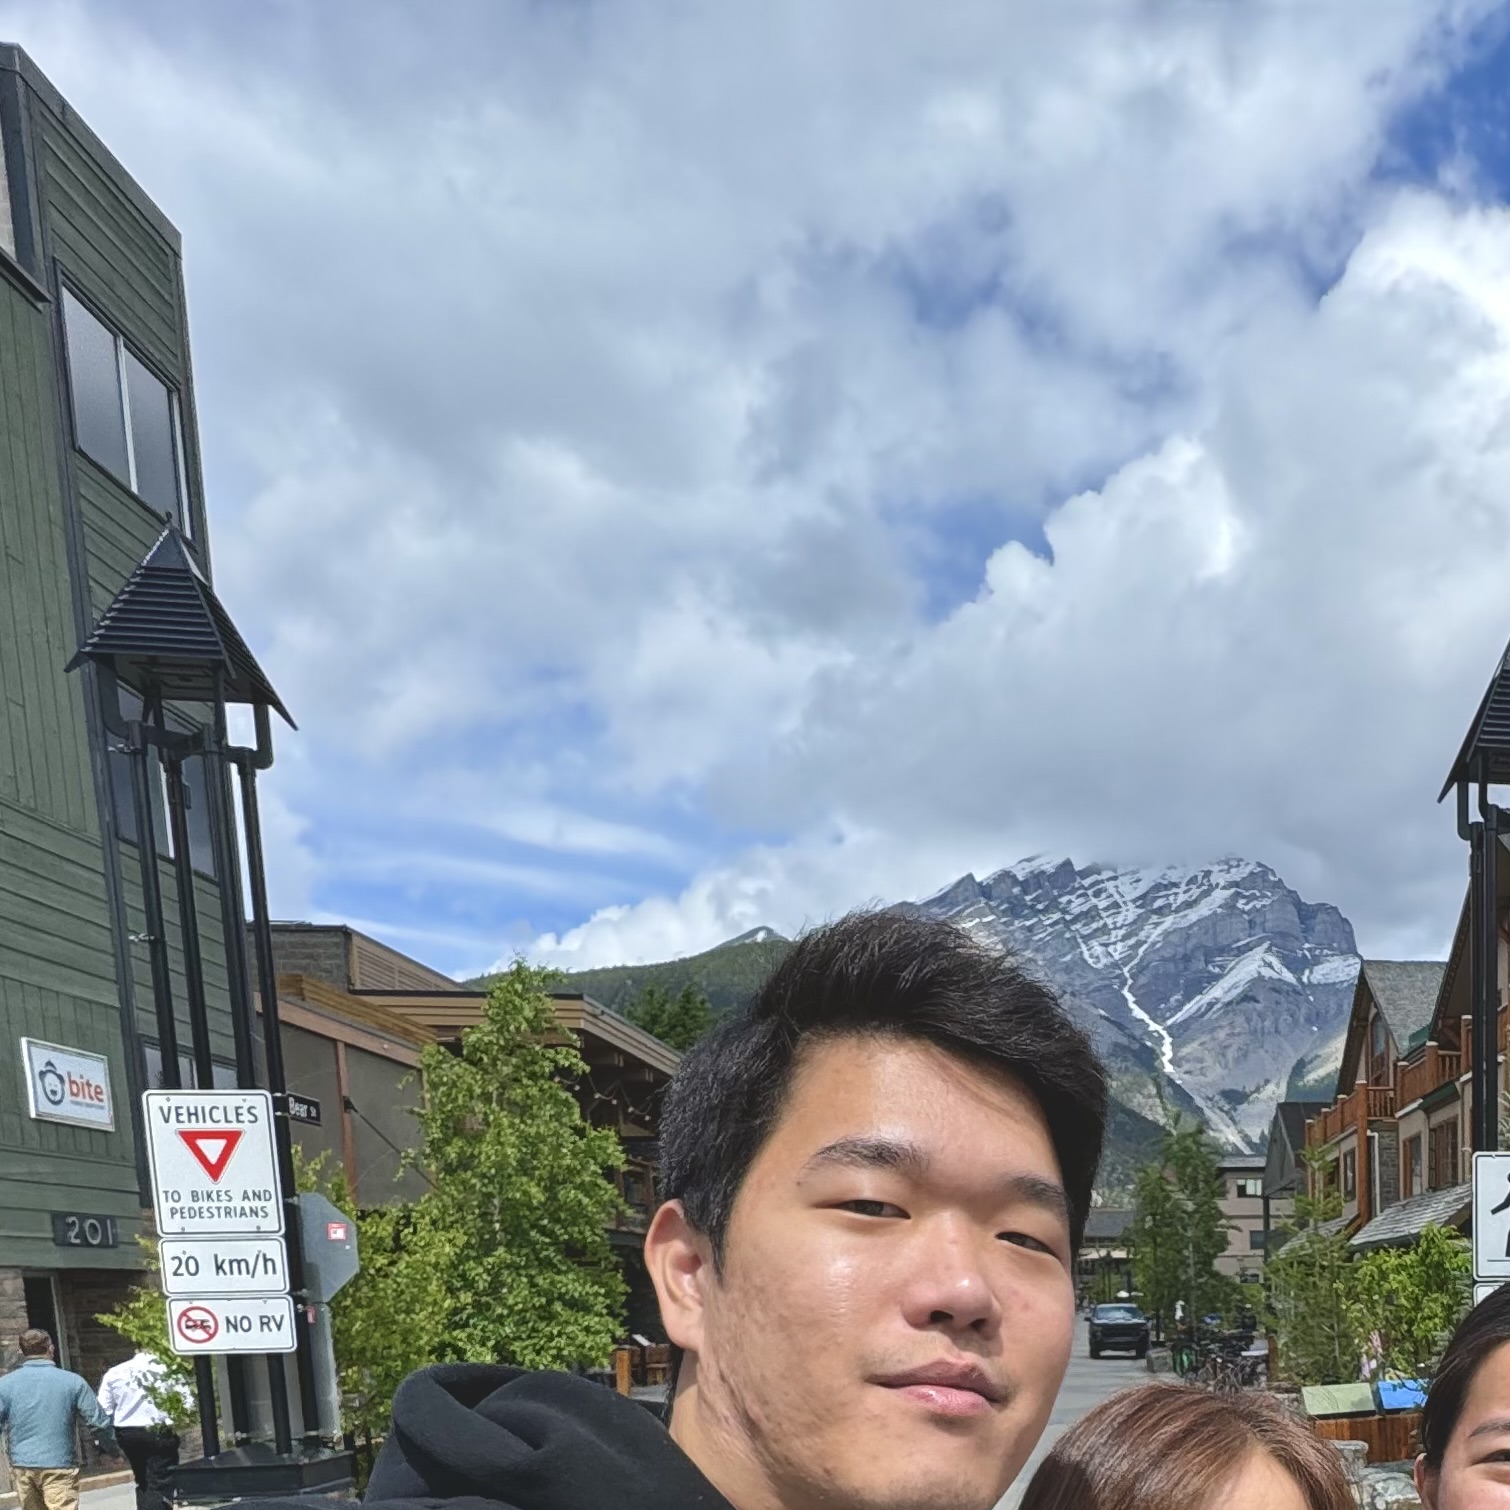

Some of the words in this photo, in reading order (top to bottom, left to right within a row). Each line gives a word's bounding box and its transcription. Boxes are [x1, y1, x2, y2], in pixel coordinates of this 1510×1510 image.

[66, 1070, 104, 1102] bite
[159, 1105, 258, 1124] VEHICLES
[162, 1190, 182, 1203] TO
[190, 1189, 233, 1203] BIKES
[241, 1189, 272, 1202] AND
[169, 1205, 269, 1219] PEDESTRIANS
[65, 1216, 113, 1245] 201
[170, 1255, 200, 1277] 20
[213, 1252, 277, 1279] km/h
[225, 1315, 252, 1333] NO
[259, 1314, 285, 1332] RV
